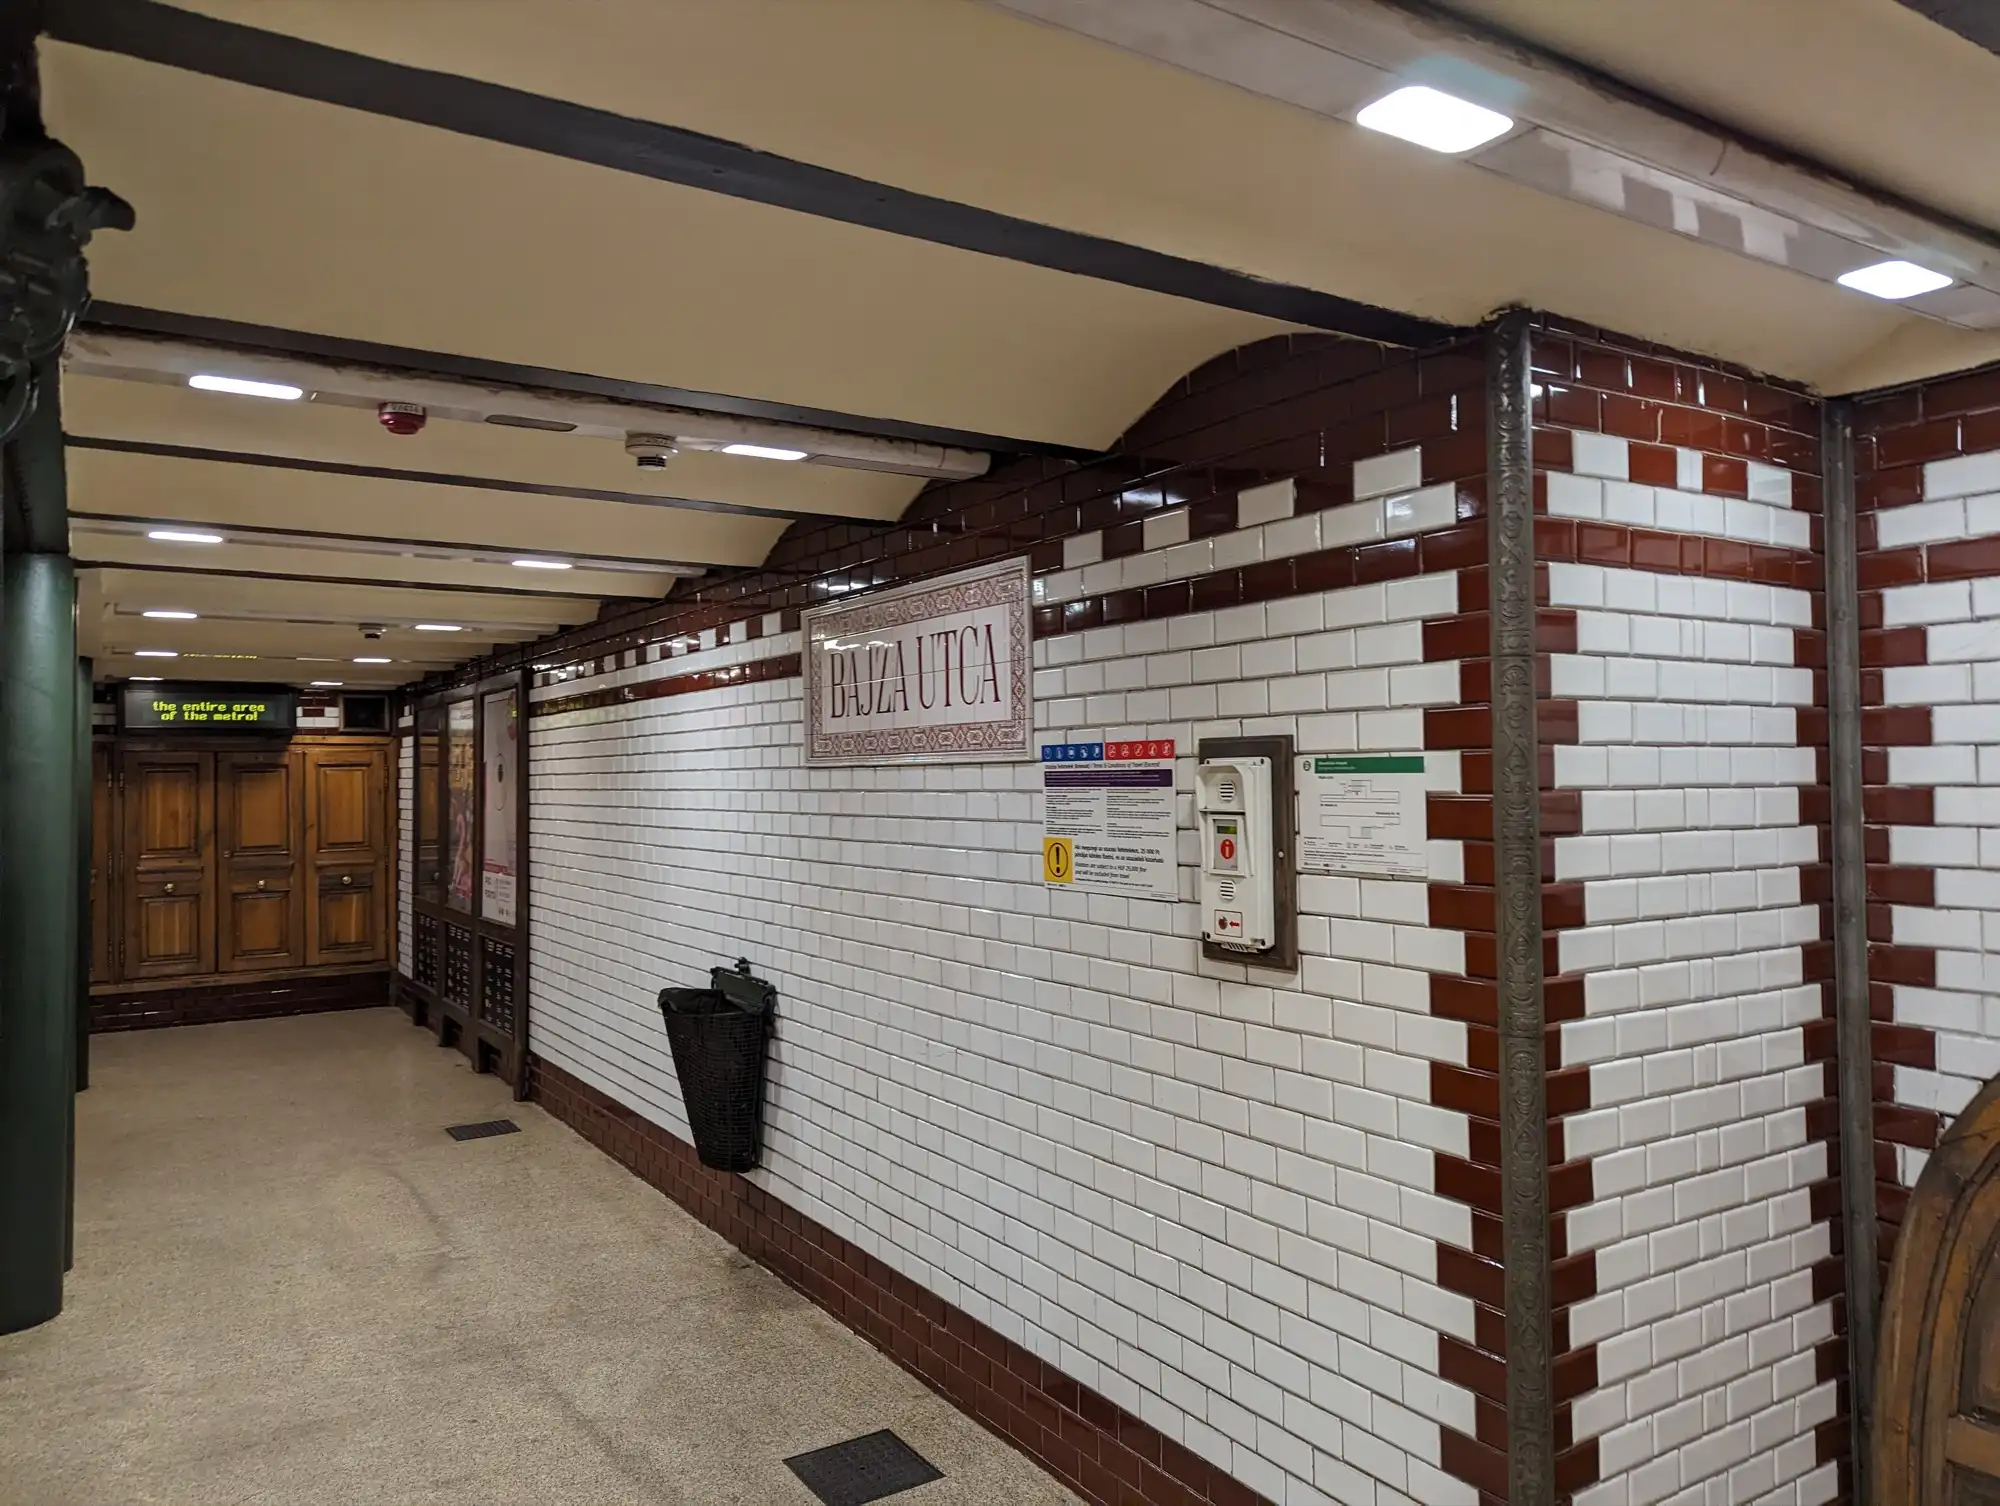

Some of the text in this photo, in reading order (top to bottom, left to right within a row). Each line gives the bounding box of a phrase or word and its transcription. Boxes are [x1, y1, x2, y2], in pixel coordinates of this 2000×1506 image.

[830, 624, 1001, 718] BAJZA UTCA
[153, 701, 266, 712] the entire area
[161, 711, 258, 721] of the metro!
